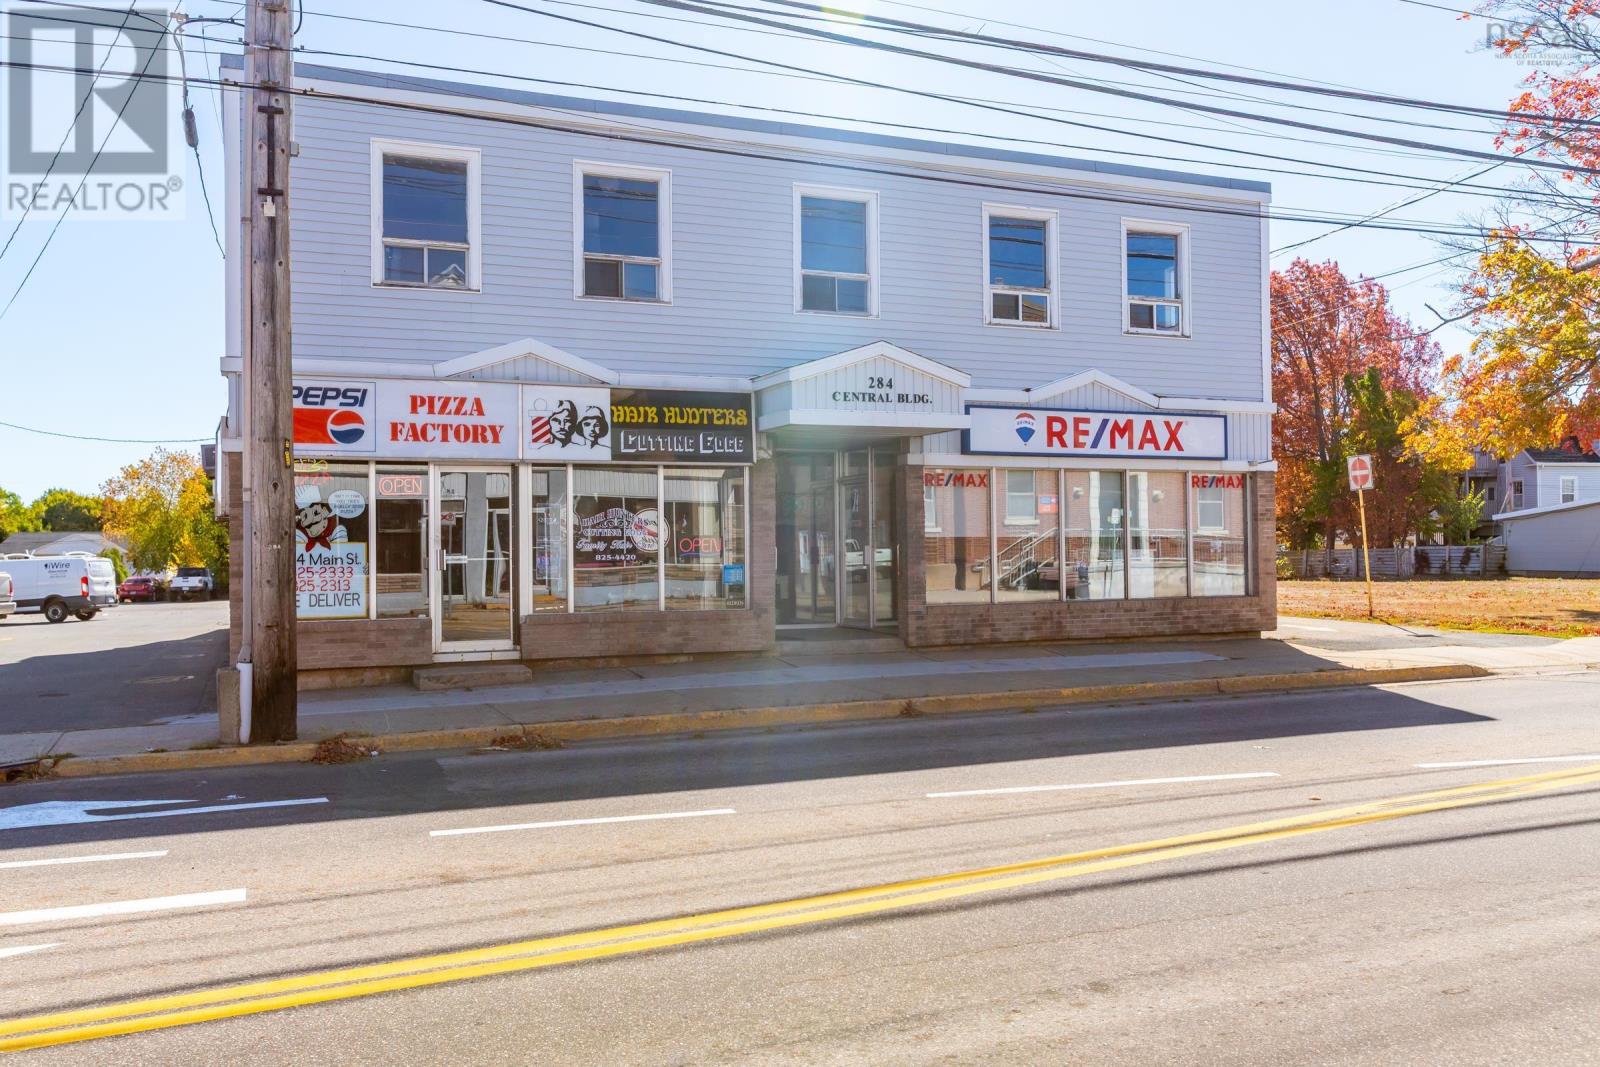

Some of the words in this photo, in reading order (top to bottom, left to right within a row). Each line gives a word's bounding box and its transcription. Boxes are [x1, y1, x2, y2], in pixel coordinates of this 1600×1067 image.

[868, 376, 893, 389] 284
[832, 391, 893, 404] CENTRAL
[897, 393, 933, 404] BLDG.
[409, 395, 485, 416] PIZZA
[611, 405, 659, 424] HAIR
[662, 406, 748, 426] HUNTERS
[389, 421, 505, 445] FACTORY
[1046, 415, 1184, 451] RE/MAX
[381, 478, 423, 493] OPEN
[924, 473, 988, 488] RE/MAX
[1191, 474, 1245, 489] RE/MAX
[679, 537, 722, 553] OPEN
[309, 552, 344, 566] Main
[346, 552, 361, 565] St.
[297, 566, 354, 579] 25-2333
[308, 592, 361, 608] DELIVER
